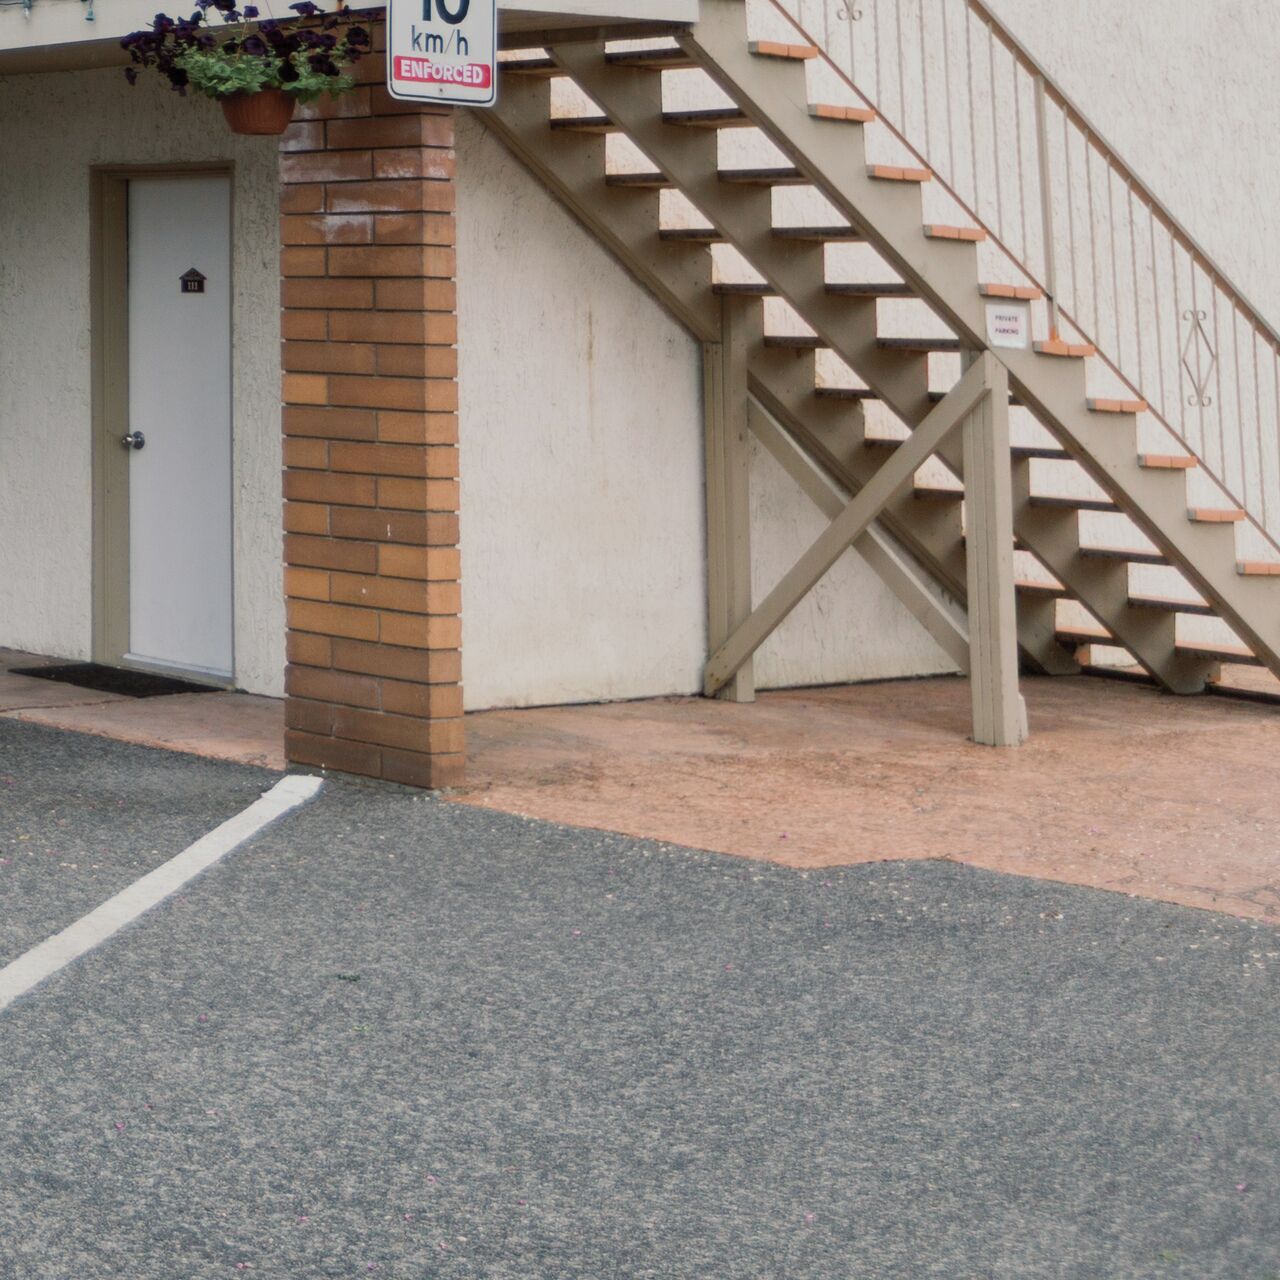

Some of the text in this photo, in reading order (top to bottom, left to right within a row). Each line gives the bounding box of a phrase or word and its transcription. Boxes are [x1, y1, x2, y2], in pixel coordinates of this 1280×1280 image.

[411, 25, 469, 56] km/h
[400, 59, 484, 84] ENFORCED
[995, 327, 1019, 335] PARKING
